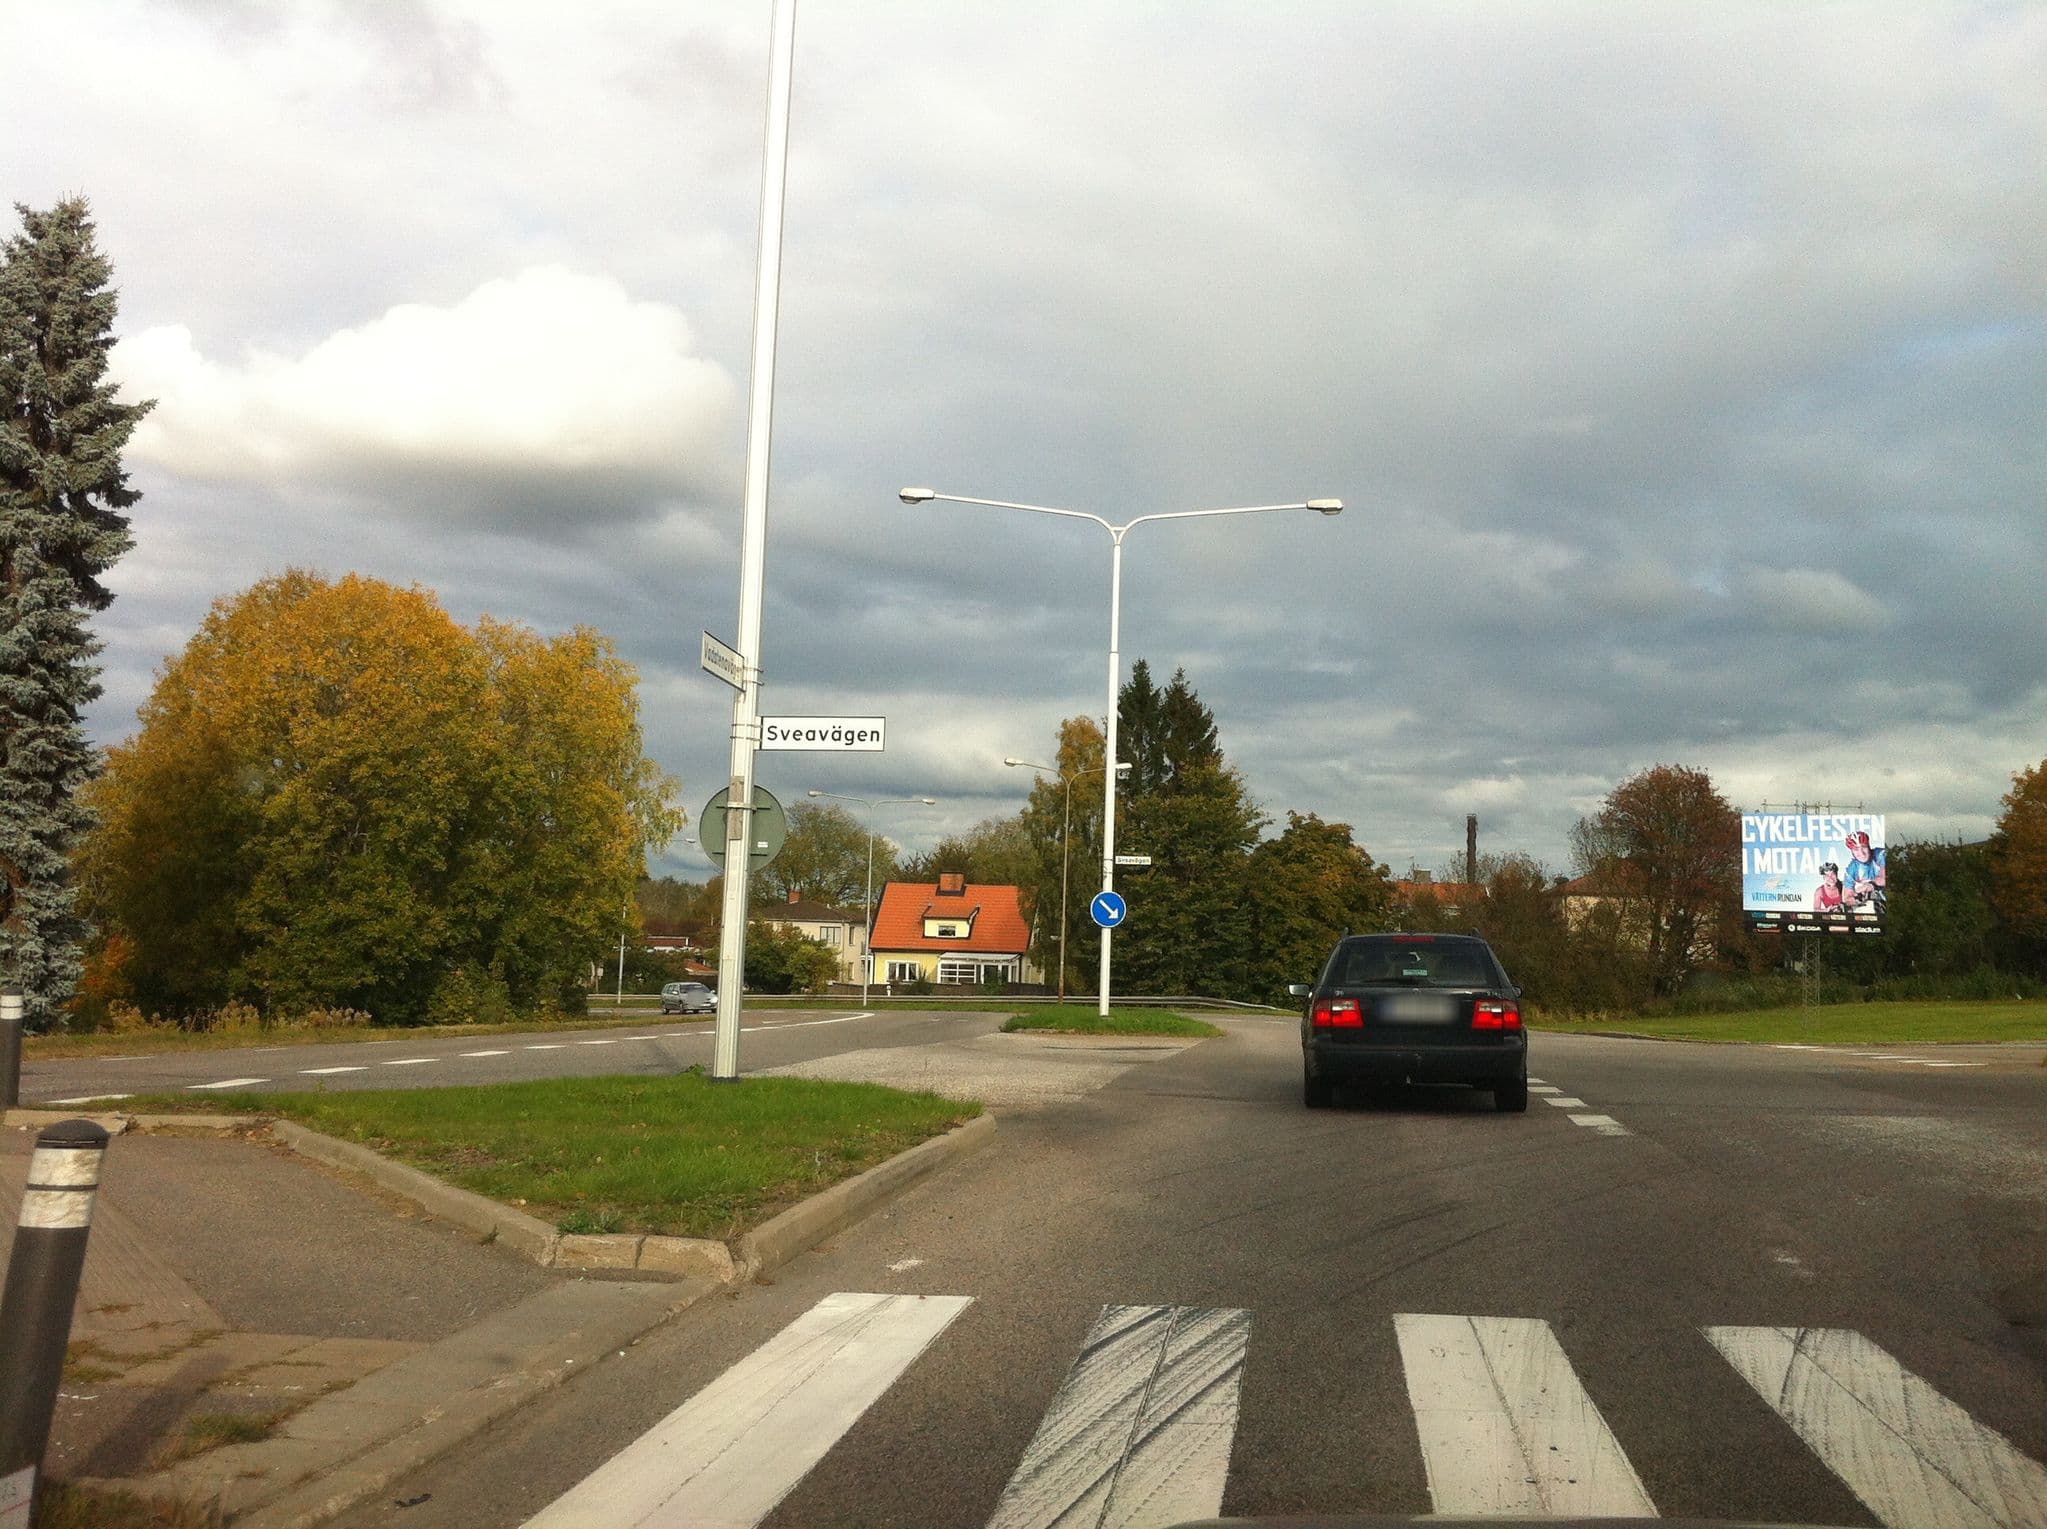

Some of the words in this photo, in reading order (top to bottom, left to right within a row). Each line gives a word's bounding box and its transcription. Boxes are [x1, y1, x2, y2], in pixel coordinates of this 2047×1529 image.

[766, 725, 881, 746] Sveavägen
[1742, 815, 1885, 848] CYKELFESTEN
[1754, 847, 1841, 875] MOTALA
